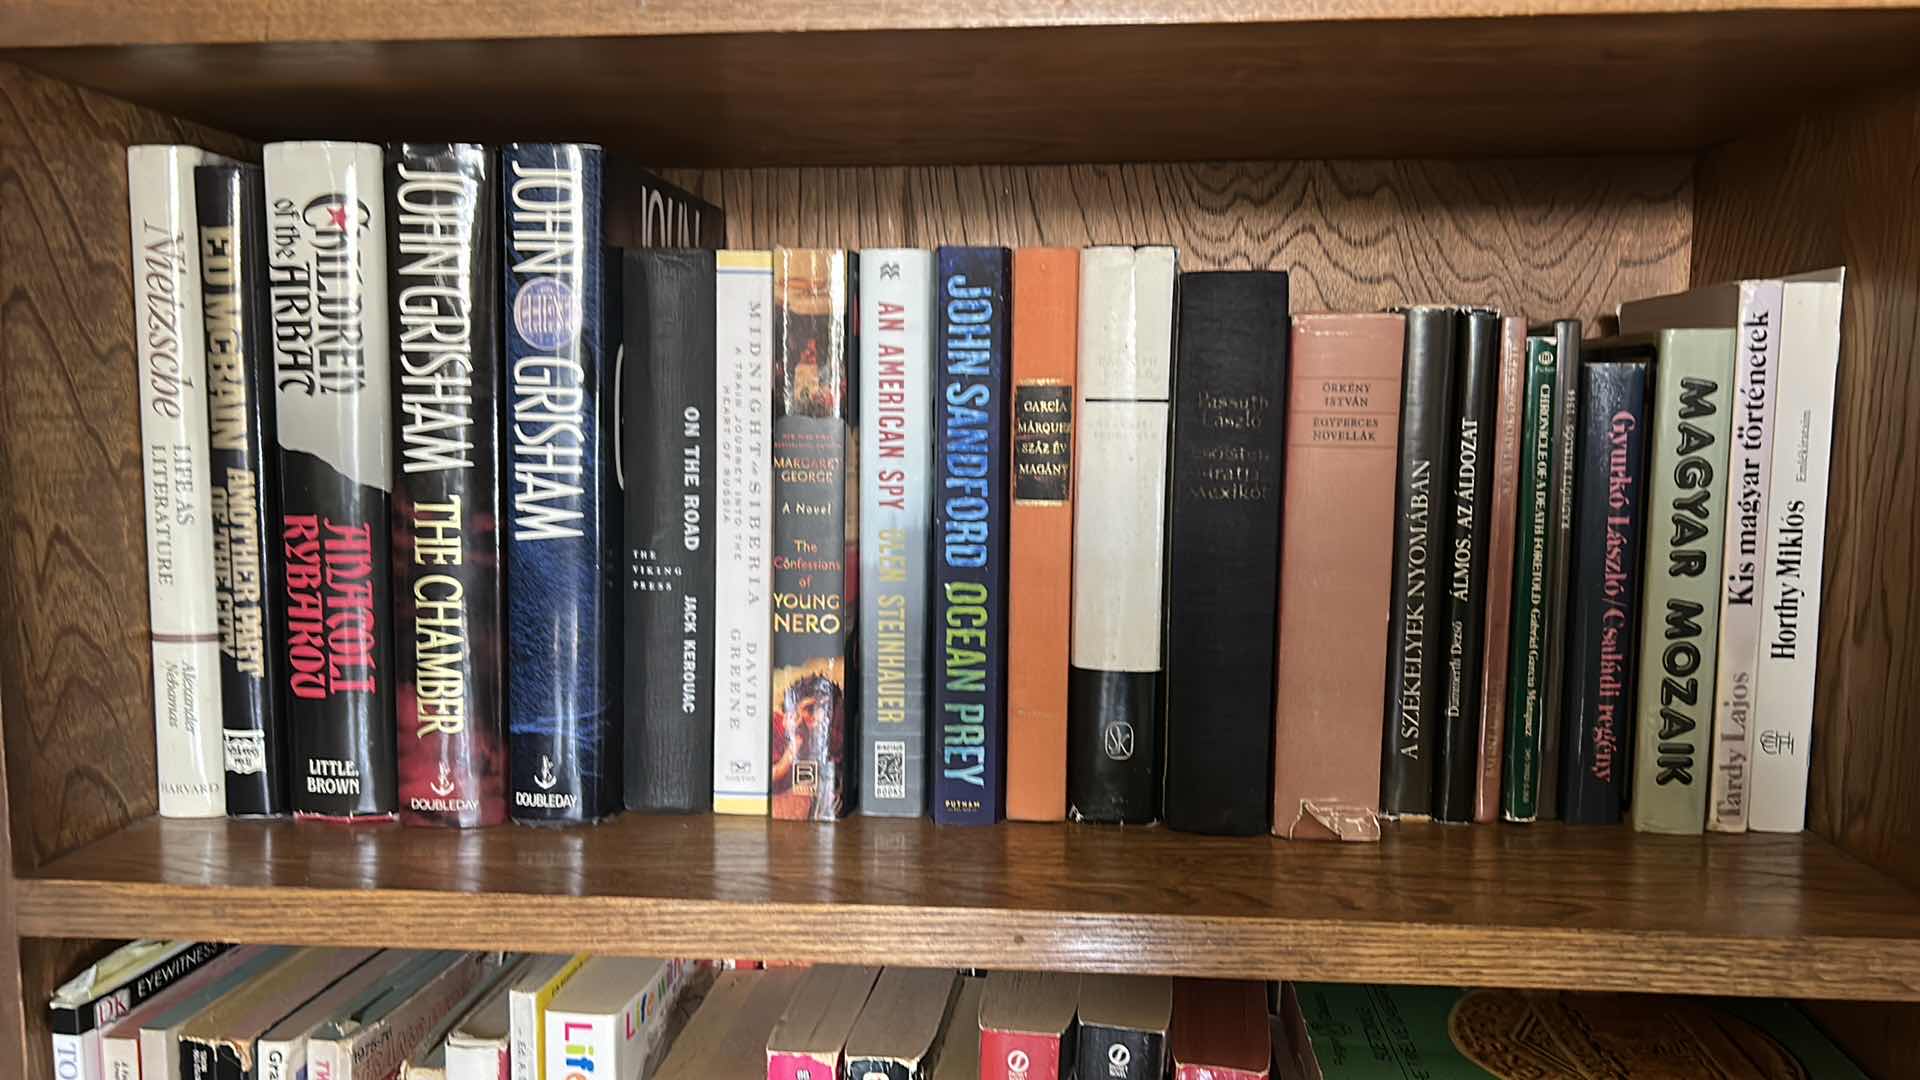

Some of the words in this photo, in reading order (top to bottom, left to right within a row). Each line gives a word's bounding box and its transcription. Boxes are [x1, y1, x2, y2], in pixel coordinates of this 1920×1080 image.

[274, 199, 300, 222] of
[275, 225, 301, 258] the
[397, 161, 476, 276] JOHN
[511, 159, 582, 274] JOHN
[201, 226, 238, 285] ED
[144, 218, 194, 419] Nietzsche
[269, 260, 315, 396] ARBAT
[878, 302, 904, 331] AN
[947, 274, 992, 376] JOHN
[399, 286, 475, 473] GRISHAM
[748, 301, 762, 457] MIDNIGHT
[878, 344, 905, 459] AMERICAN
[1737, 309, 1769, 450] történetek
[513, 356, 584, 540] GRISHAM
[683, 406, 699, 437] ON
[1536, 384, 1551, 460] CHRONICLE
[173, 445, 192, 492] LIFE
[684, 445, 699, 486] THE
[781, 471, 833, 483] GEORGE
[878, 469, 905, 511] SPY
[945, 382, 990, 569] SANDFORD
[1453, 417, 1478, 502] ÁLDOZAT
[1537, 461, 1548, 479] OF
[1606, 410, 1637, 510] Gyurkó
[1669, 376, 1718, 578] MAGYAR
[152, 445, 173, 585] LITERATURE
[176, 495, 195, 525] AS
[226, 467, 261, 603] ANOTHER
[413, 494, 462, 565] THE
[683, 494, 698, 550] ROAD
[782, 503, 791, 515] A
[795, 503, 832, 515] Novel
[1405, 460, 1431, 597] NYOMÁBAN
[1457, 506, 1472, 531] AZ
[1534, 491, 1546, 535] DEATH
[1739, 458, 1763, 555] magyar
[1775, 501, 1805, 579] Miklós
[632, 550, 656, 560] THE
[632, 565, 682, 576] VIKING
[747, 481, 761, 606] SIBERIA
[773, 557, 840, 570] Confessions
[794, 539, 817, 553] The
[1531, 536, 1545, 604] FORETOLD
[282, 514, 328, 700] RYBAKOV
[632, 581, 672, 591] PRESS
[683, 594, 697, 632] JACK
[773, 593, 840, 610] YOUNG
[799, 575, 811, 589] of
[1728, 563, 1754, 607] Kis
[234, 604, 264, 678] PART
[412, 574, 464, 739] CHAMBER
[773, 613, 840, 634] NERO
[944, 581, 988, 693] OCEAN
[1771, 582, 1805, 659] Horthy
[683, 639, 697, 713] KEROUAC
[729, 628, 742, 730] GREENE
[746, 642, 758, 719] DAVID
[877, 594, 906, 723] STEINHAUER
[1398, 604, 1424, 738] SZÉKELYEK
[1656, 598, 1704, 786] MOZAIK
[182, 660, 198, 736] Alexander
[1722, 672, 1750, 742] Lajos
[944, 702, 985, 788] PREY
[1400, 745, 1418, 760] A
[1592, 704, 1618, 782] regény
[161, 783, 220, 794] HARVARD
[307, 776, 360, 794] BROWN
[411, 798, 479, 812] DOUBLEDAY
[516, 792, 577, 808] DOUBLEDAY
[945, 799, 981, 808] PUTNAM
[1716, 749, 1748, 822] Tardy
[137, 942, 219, 999] EYEWITNESS
[98, 995, 128, 1024] DK
